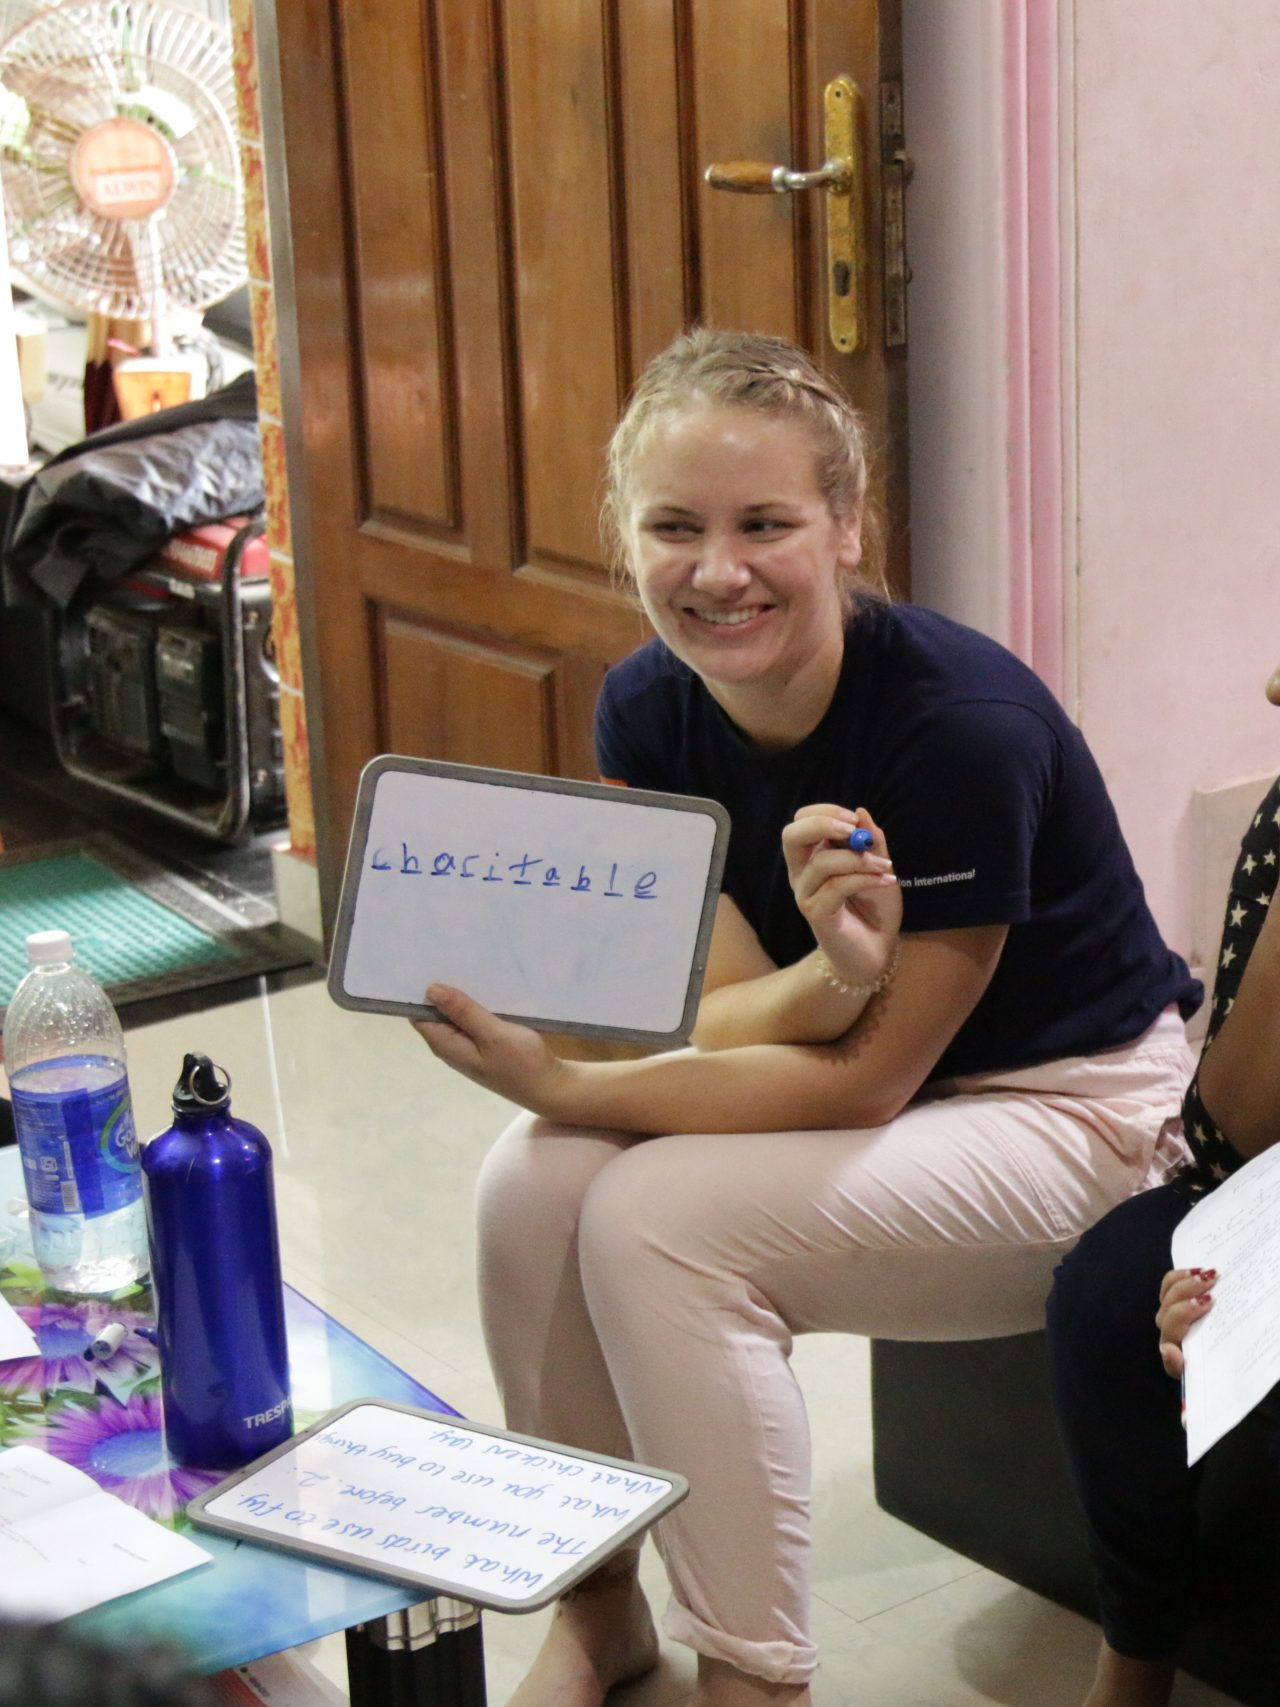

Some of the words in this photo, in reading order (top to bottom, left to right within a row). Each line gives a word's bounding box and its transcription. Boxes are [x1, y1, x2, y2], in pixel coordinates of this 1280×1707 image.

[371, 842, 658, 899] charitable
[369, 1446, 417, 1468] buy
[481, 1444, 584, 1476] chickens
[418, 1461, 446, 1477] to
[450, 1470, 495, 1487] use
[502, 1483, 554, 1500] you
[591, 1472, 664, 1496] What
[237, 1493, 284, 1516] fly.
[559, 1496, 631, 1521] What
[284, 1510, 317, 1526] to
[321, 1518, 374, 1539] use
[415, 1505, 532, 1538] number
[376, 1534, 451, 1561] birds
[537, 1532, 587, 1555] The
[463, 1553, 544, 1589] What
